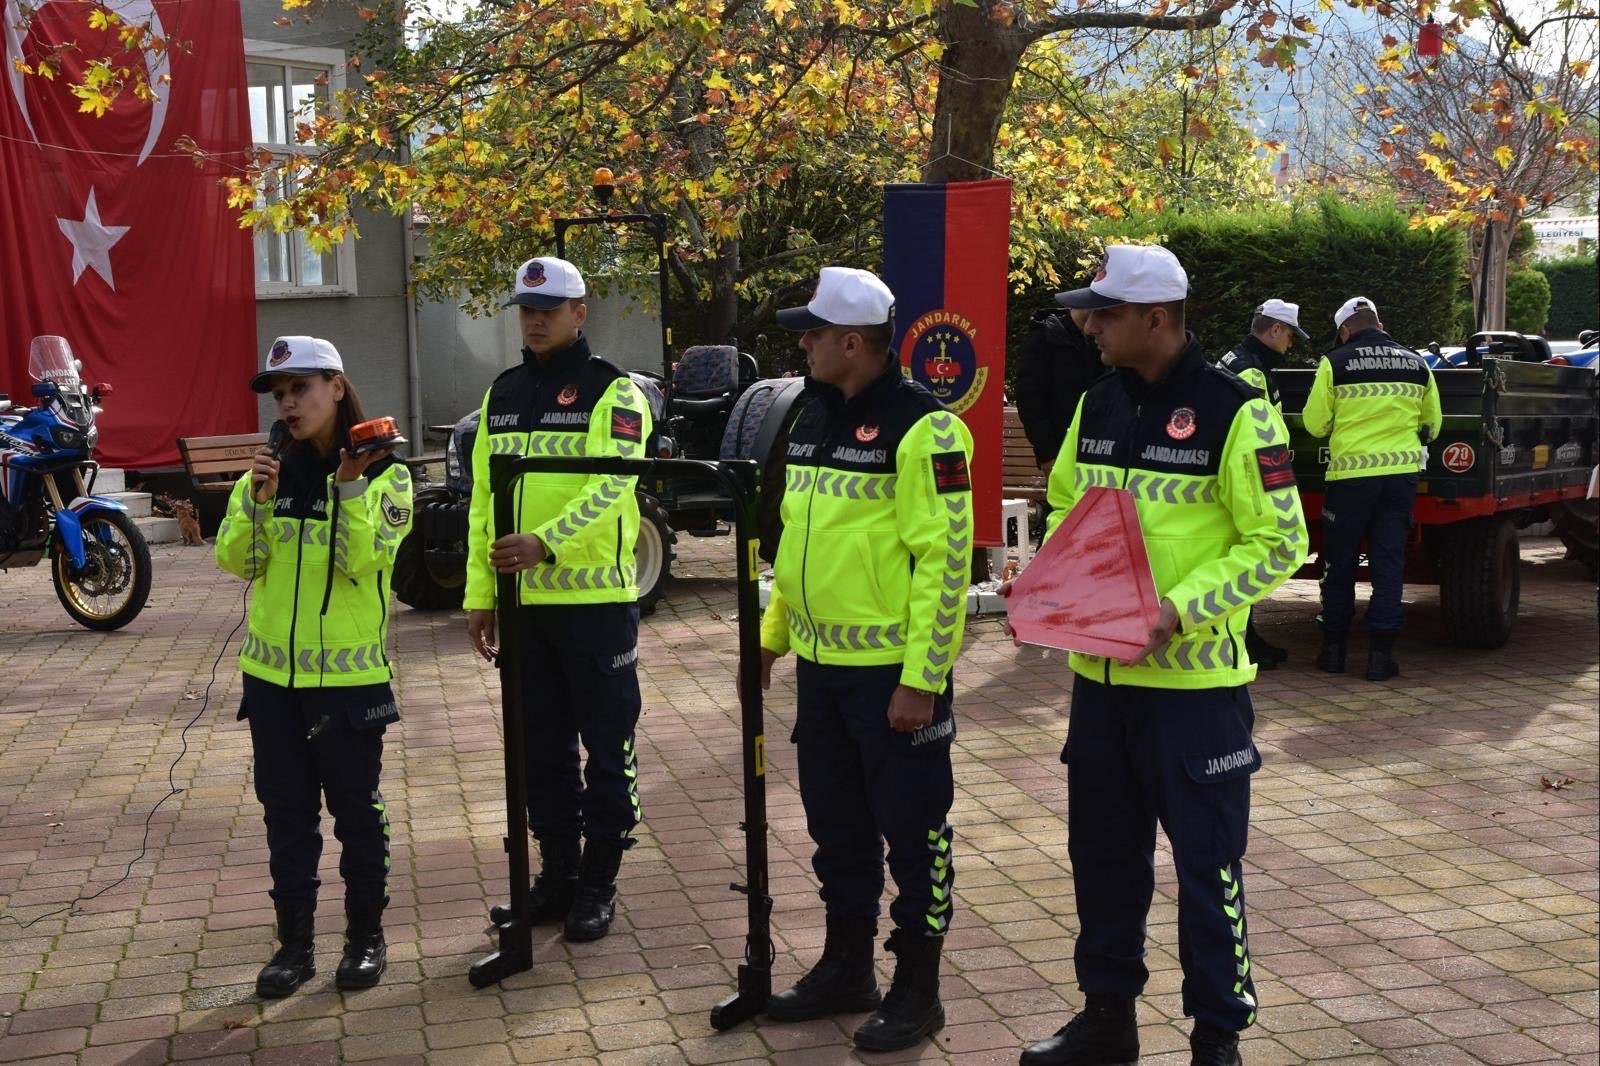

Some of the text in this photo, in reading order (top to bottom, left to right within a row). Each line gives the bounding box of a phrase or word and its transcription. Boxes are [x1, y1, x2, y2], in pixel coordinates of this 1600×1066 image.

[912, 312, 977, 338] JANDARMA
[1345, 357, 1420, 371] JANDARMASI
[540, 412, 591, 425] JANDARMAS
[1141, 445, 1209, 466] JANDARMASI
[1449, 447, 1469, 466] 20
